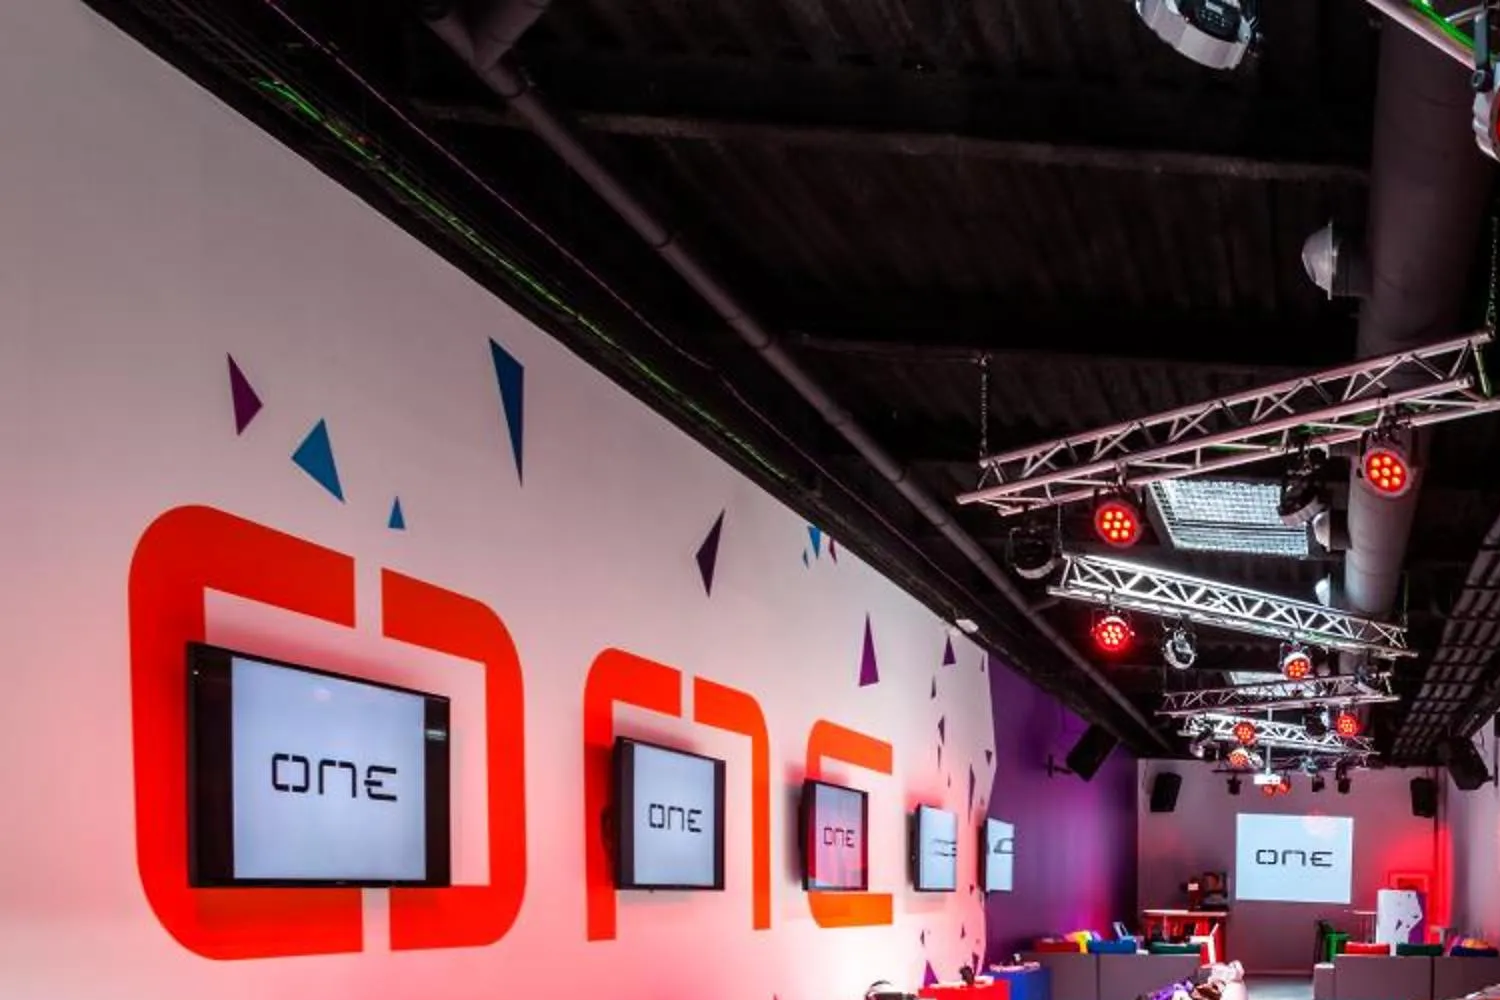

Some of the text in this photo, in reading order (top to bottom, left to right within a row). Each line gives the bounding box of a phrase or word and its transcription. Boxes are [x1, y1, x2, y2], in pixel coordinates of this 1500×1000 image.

[272, 753, 398, 802] ONE
[648, 803, 702, 833] ONE
[1255, 849, 1333, 868] ONE
